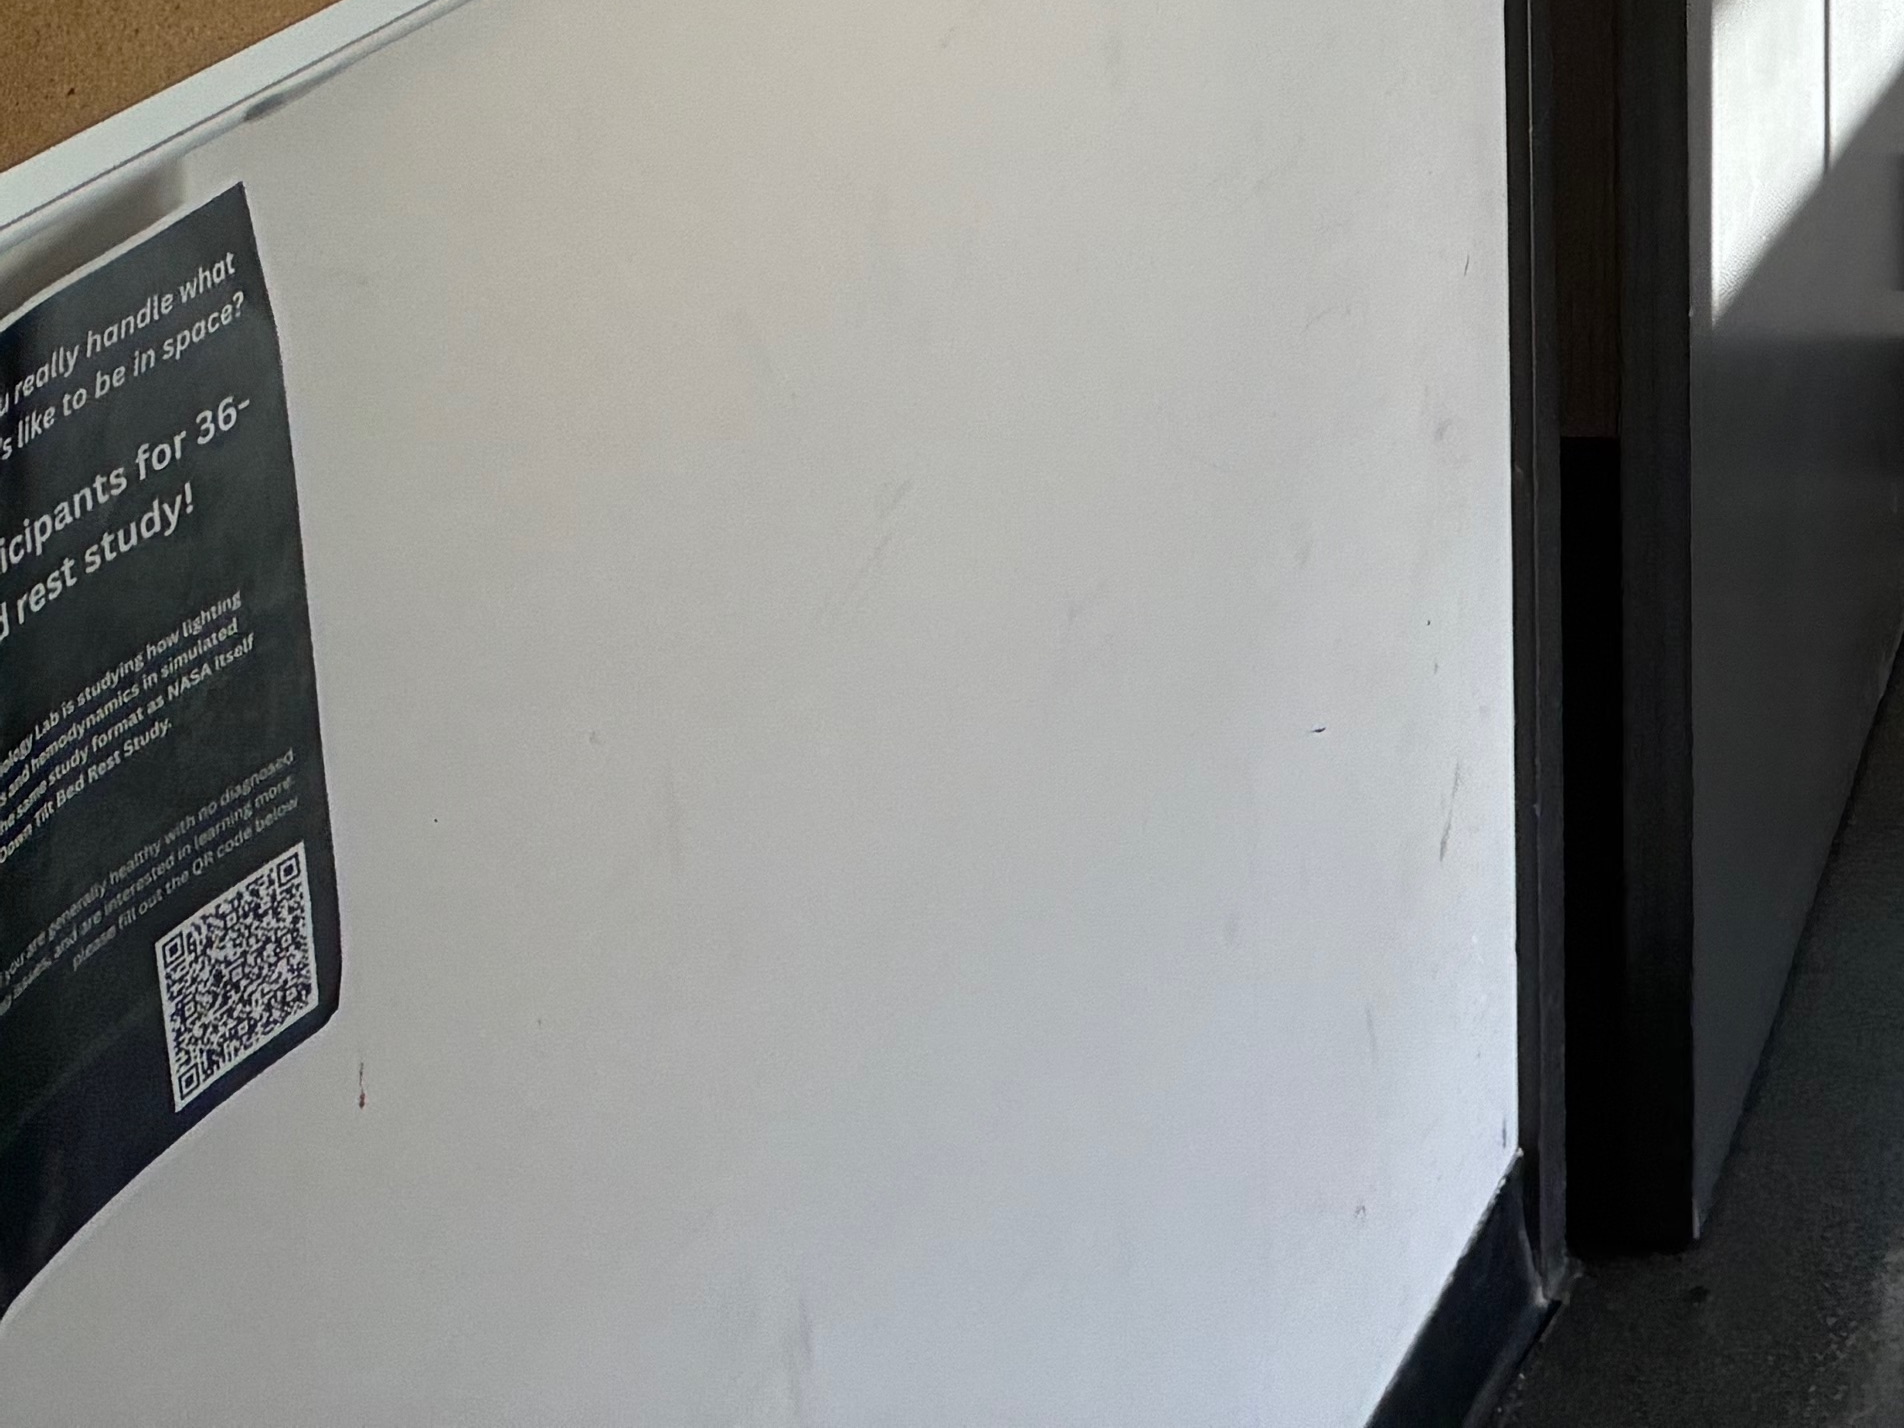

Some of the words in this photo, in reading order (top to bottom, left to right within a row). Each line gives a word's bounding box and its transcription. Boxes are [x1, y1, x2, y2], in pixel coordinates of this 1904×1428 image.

[13, 344, 79, 406] really
[86, 290, 174, 358] handle
[179, 251, 237, 306] what
[17, 403, 56, 449] like
[62, 386, 87, 417] to
[95, 364, 126, 399] be
[133, 347, 156, 376] in
[162, 291, 246, 362] space?
[136, 428, 187, 480] for
[195, 394, 251, 446] 36-
[16, 556, 78, 625] rest
[85, 481, 195, 574] study!
[31, 684, 140, 772] hemodynamics
[142, 673, 158, 690] in
[161, 618, 238, 677] simulated
[35, 711, 59, 741] Lab
[62, 701, 75, 719] is
[77, 652, 145, 706] studying
[146, 629, 180, 660] how
[182, 590, 242, 637] lighting
[48, 745, 89, 786] study
[91, 709, 145, 752] format
[146, 696, 165, 714] as
[167, 666, 213, 701] NASA
[214, 633, 255, 670] itself
[56, 779, 85, 809] Bed
[88, 752, 121, 784] Rest
[123, 717, 173, 757] Study.
[164, 816, 196, 845] with
[198, 802, 217, 821] no
[178, 845, 192, 862] in
[192, 851, 214, 876] QR
[216, 826, 253, 858] code
